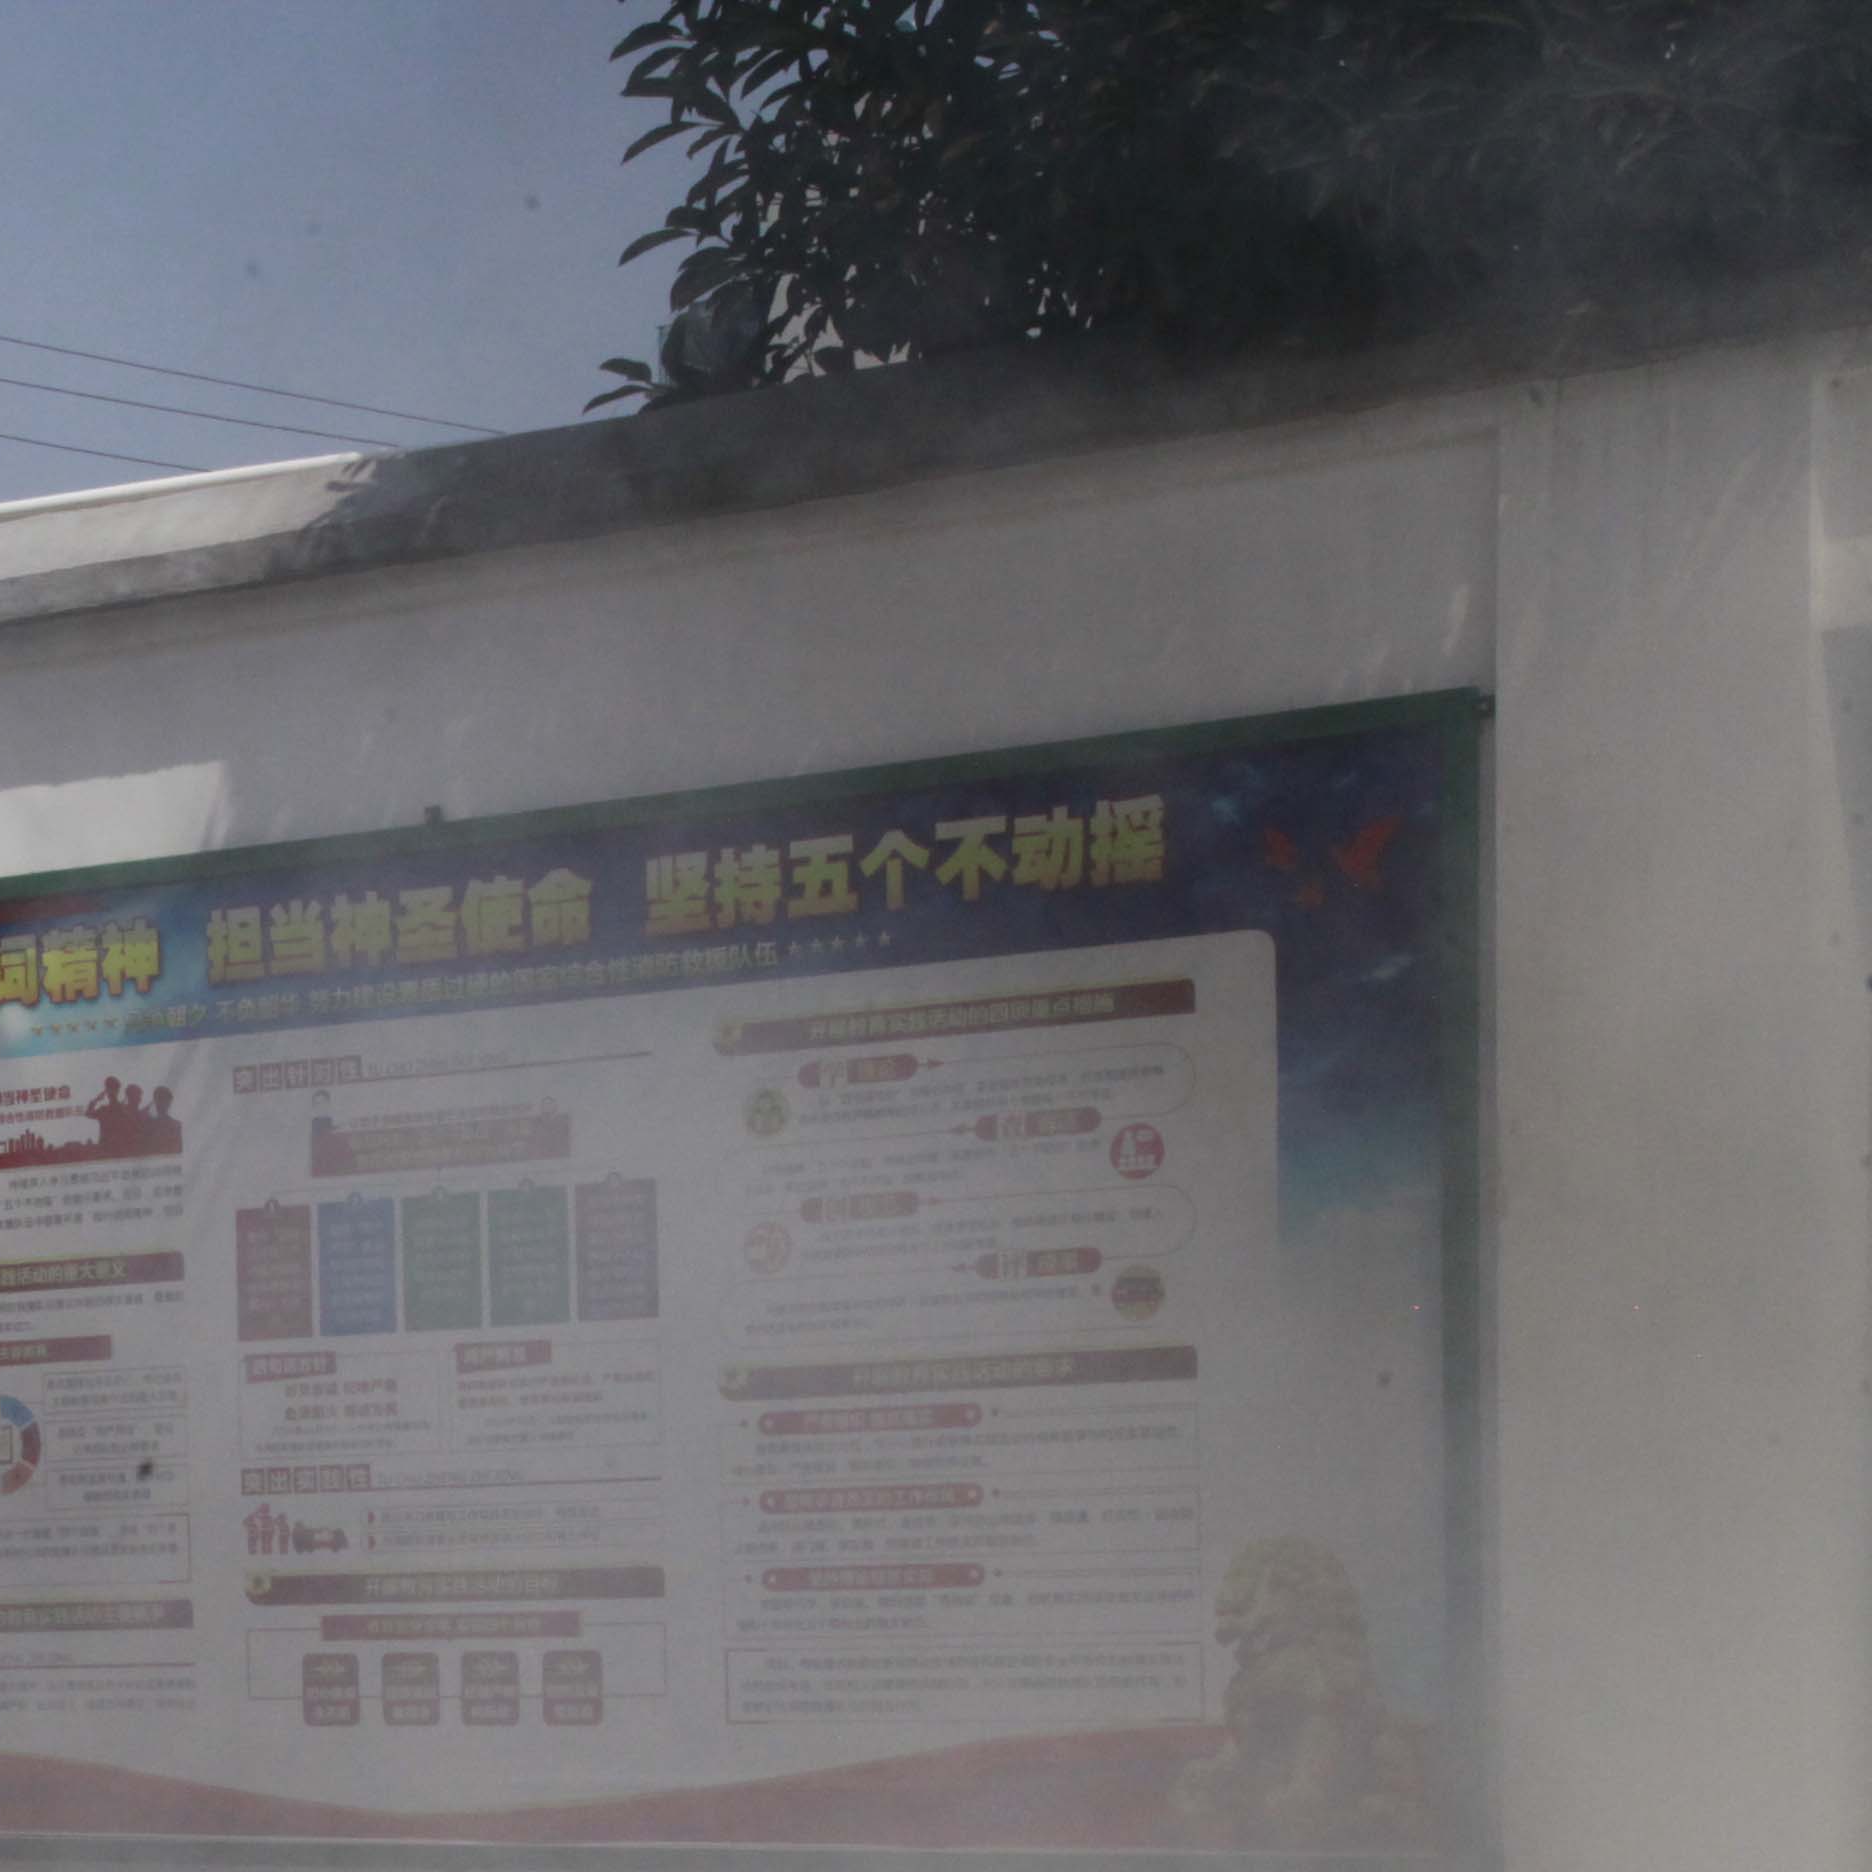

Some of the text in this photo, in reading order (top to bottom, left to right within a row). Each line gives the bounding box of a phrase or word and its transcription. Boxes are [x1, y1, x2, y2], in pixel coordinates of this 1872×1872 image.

[207, 867, 594, 984] 担当神圣使命
[644, 793, 1168, 938] 坚持五个不动摇
